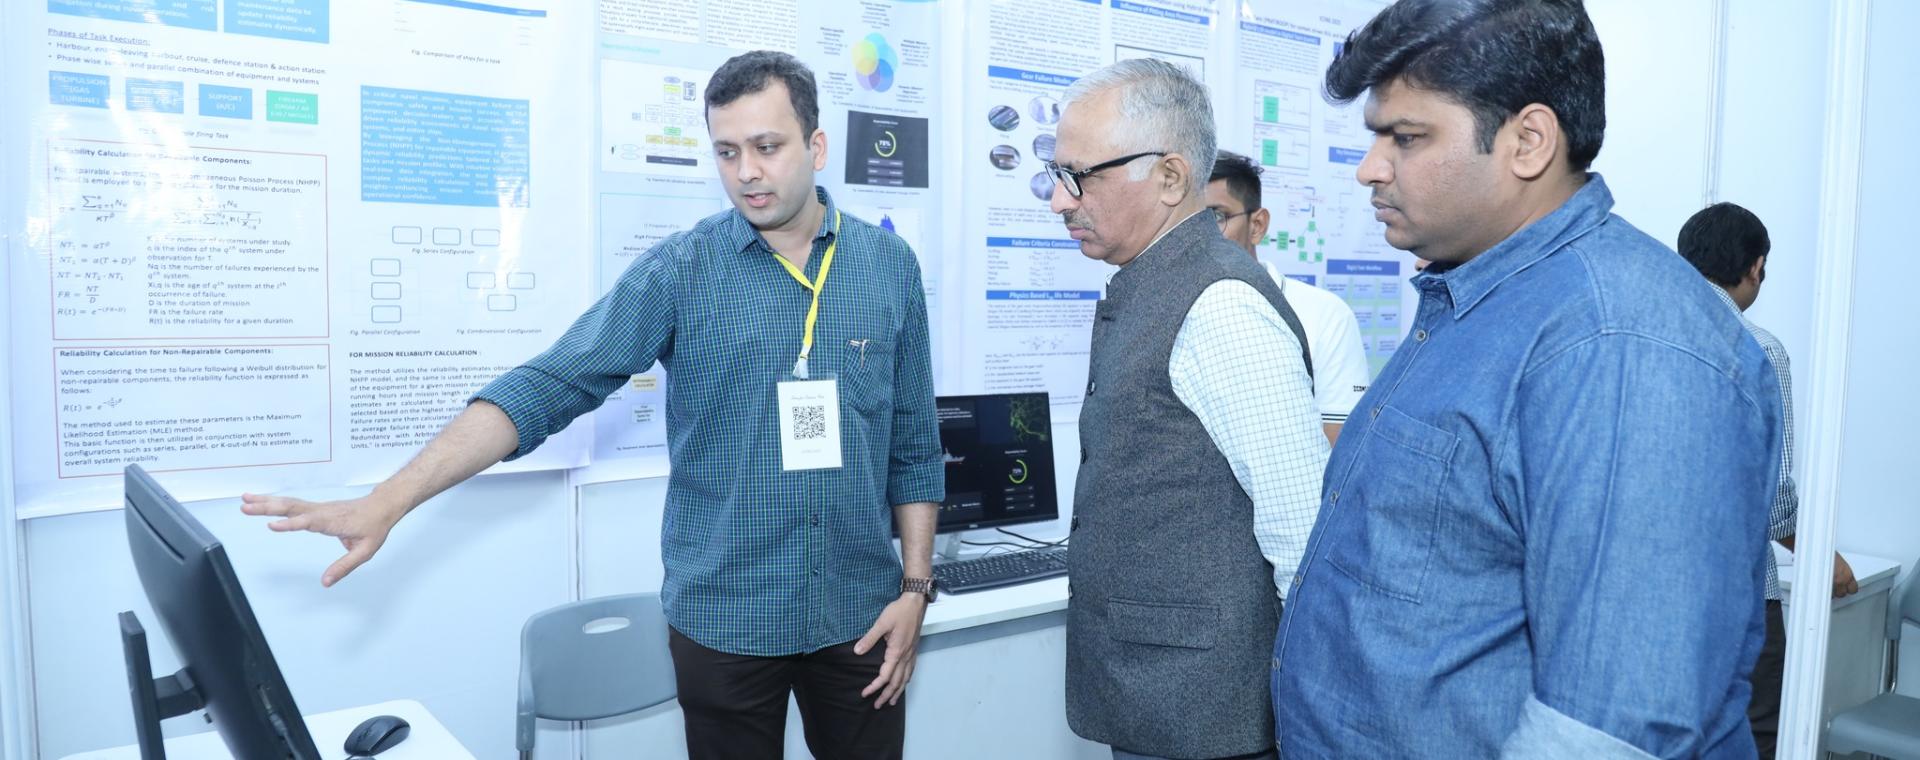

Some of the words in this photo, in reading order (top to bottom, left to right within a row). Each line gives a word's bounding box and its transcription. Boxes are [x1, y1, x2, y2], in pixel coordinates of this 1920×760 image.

[47, 28, 77, 38] Phases
[56, 54, 81, 62] Phase
[212, 57, 241, 66] defence
[243, 61, 268, 69] station
[277, 64, 299, 72] action
[146, 62, 174, 72] parallel
[177, 66, 224, 76] combination
[235, 72, 274, 81] equipment
[291, 77, 319, 85] systems
[208, 92, 242, 102] SUPPORT
[238, 175, 265, 183] Poisson
[267, 177, 294, 185] Process
[1009, 292, 1029, 300] Physics
[1063, 291, 1080, 299] Model
[204, 365, 237, 373] following
[63, 421, 77, 429] The
[63, 430, 104, 438] Likelihood
[204, 433, 247, 441] conjunction
[381, 440, 413, 448] employed
[63, 448, 120, 457] configurations
[220, 440, 258, 448] K-out-of-N
[64, 458, 91, 466] overall
